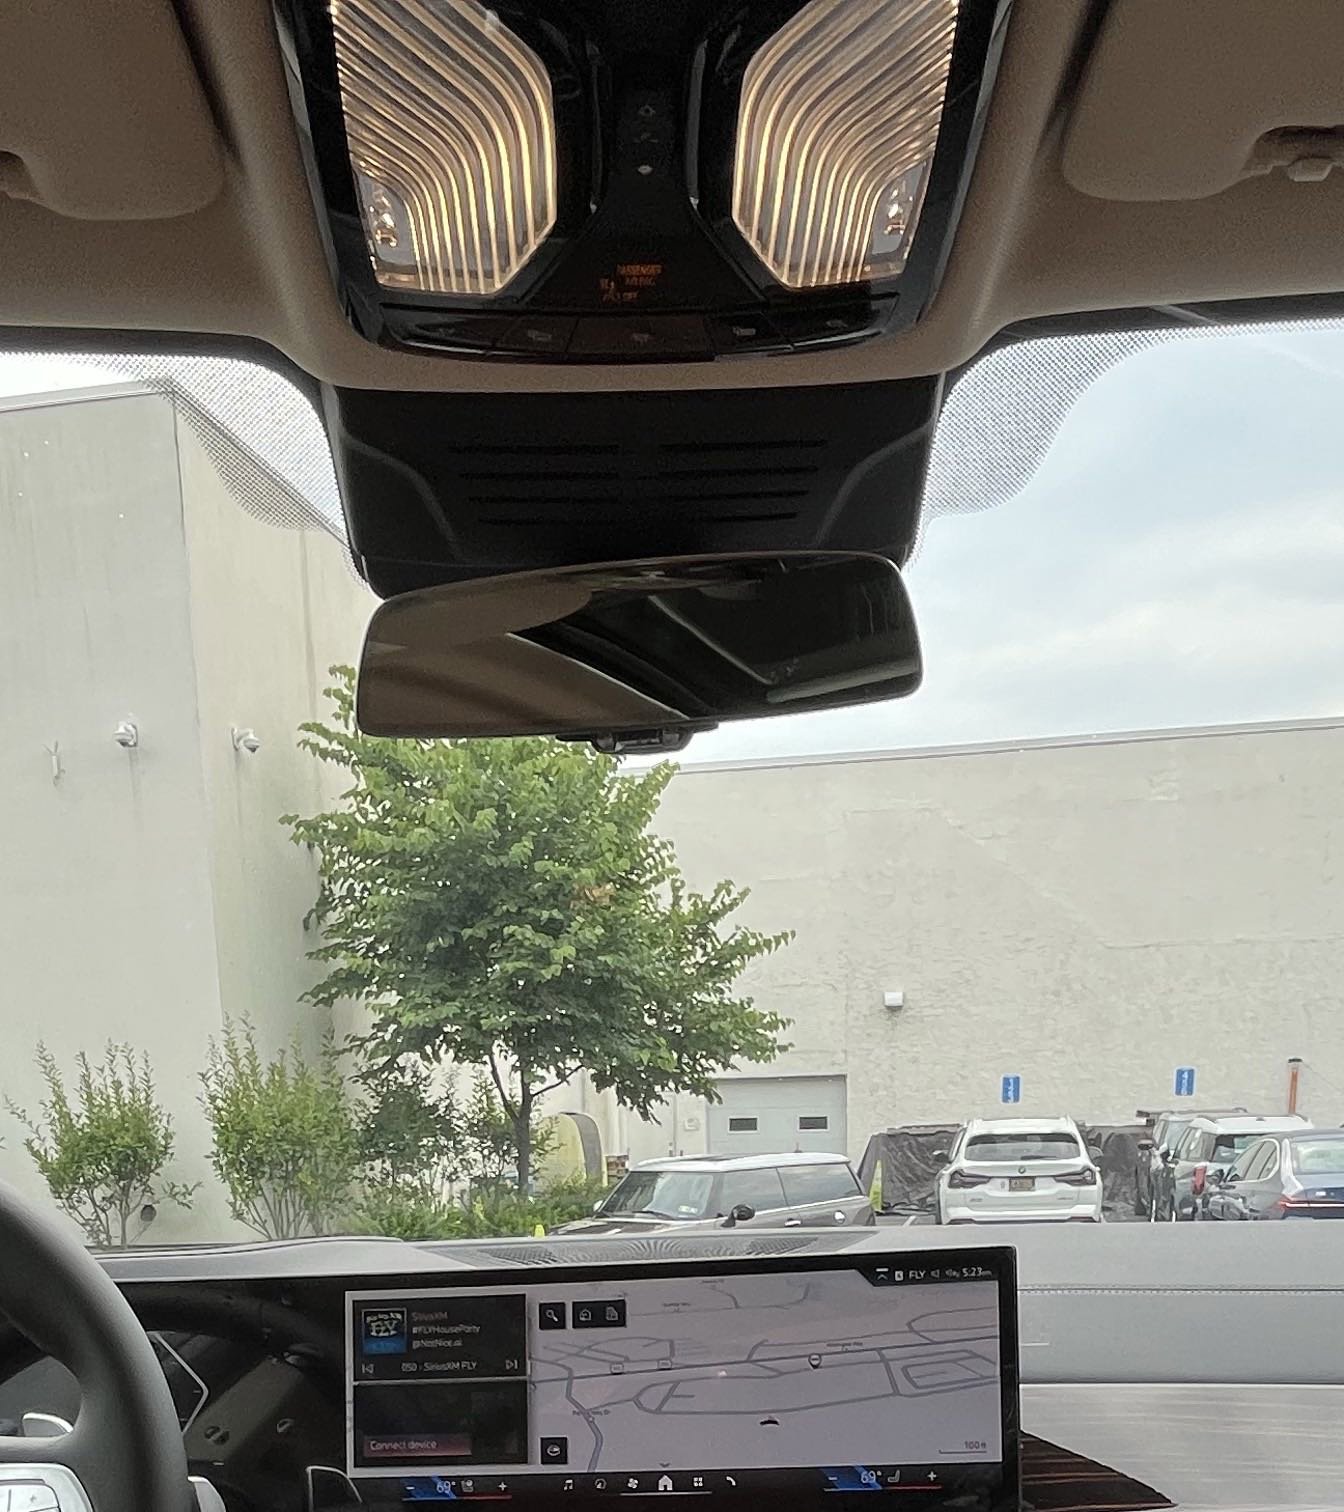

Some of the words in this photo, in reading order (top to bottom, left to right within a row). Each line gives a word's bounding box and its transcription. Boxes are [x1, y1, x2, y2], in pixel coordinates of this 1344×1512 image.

[908, 1269, 926, 1280] FLY
[461, 1360, 477, 1370] FLY
[369, 1440, 406, 1450] Connect
[407, 1439, 437, 1450] device
